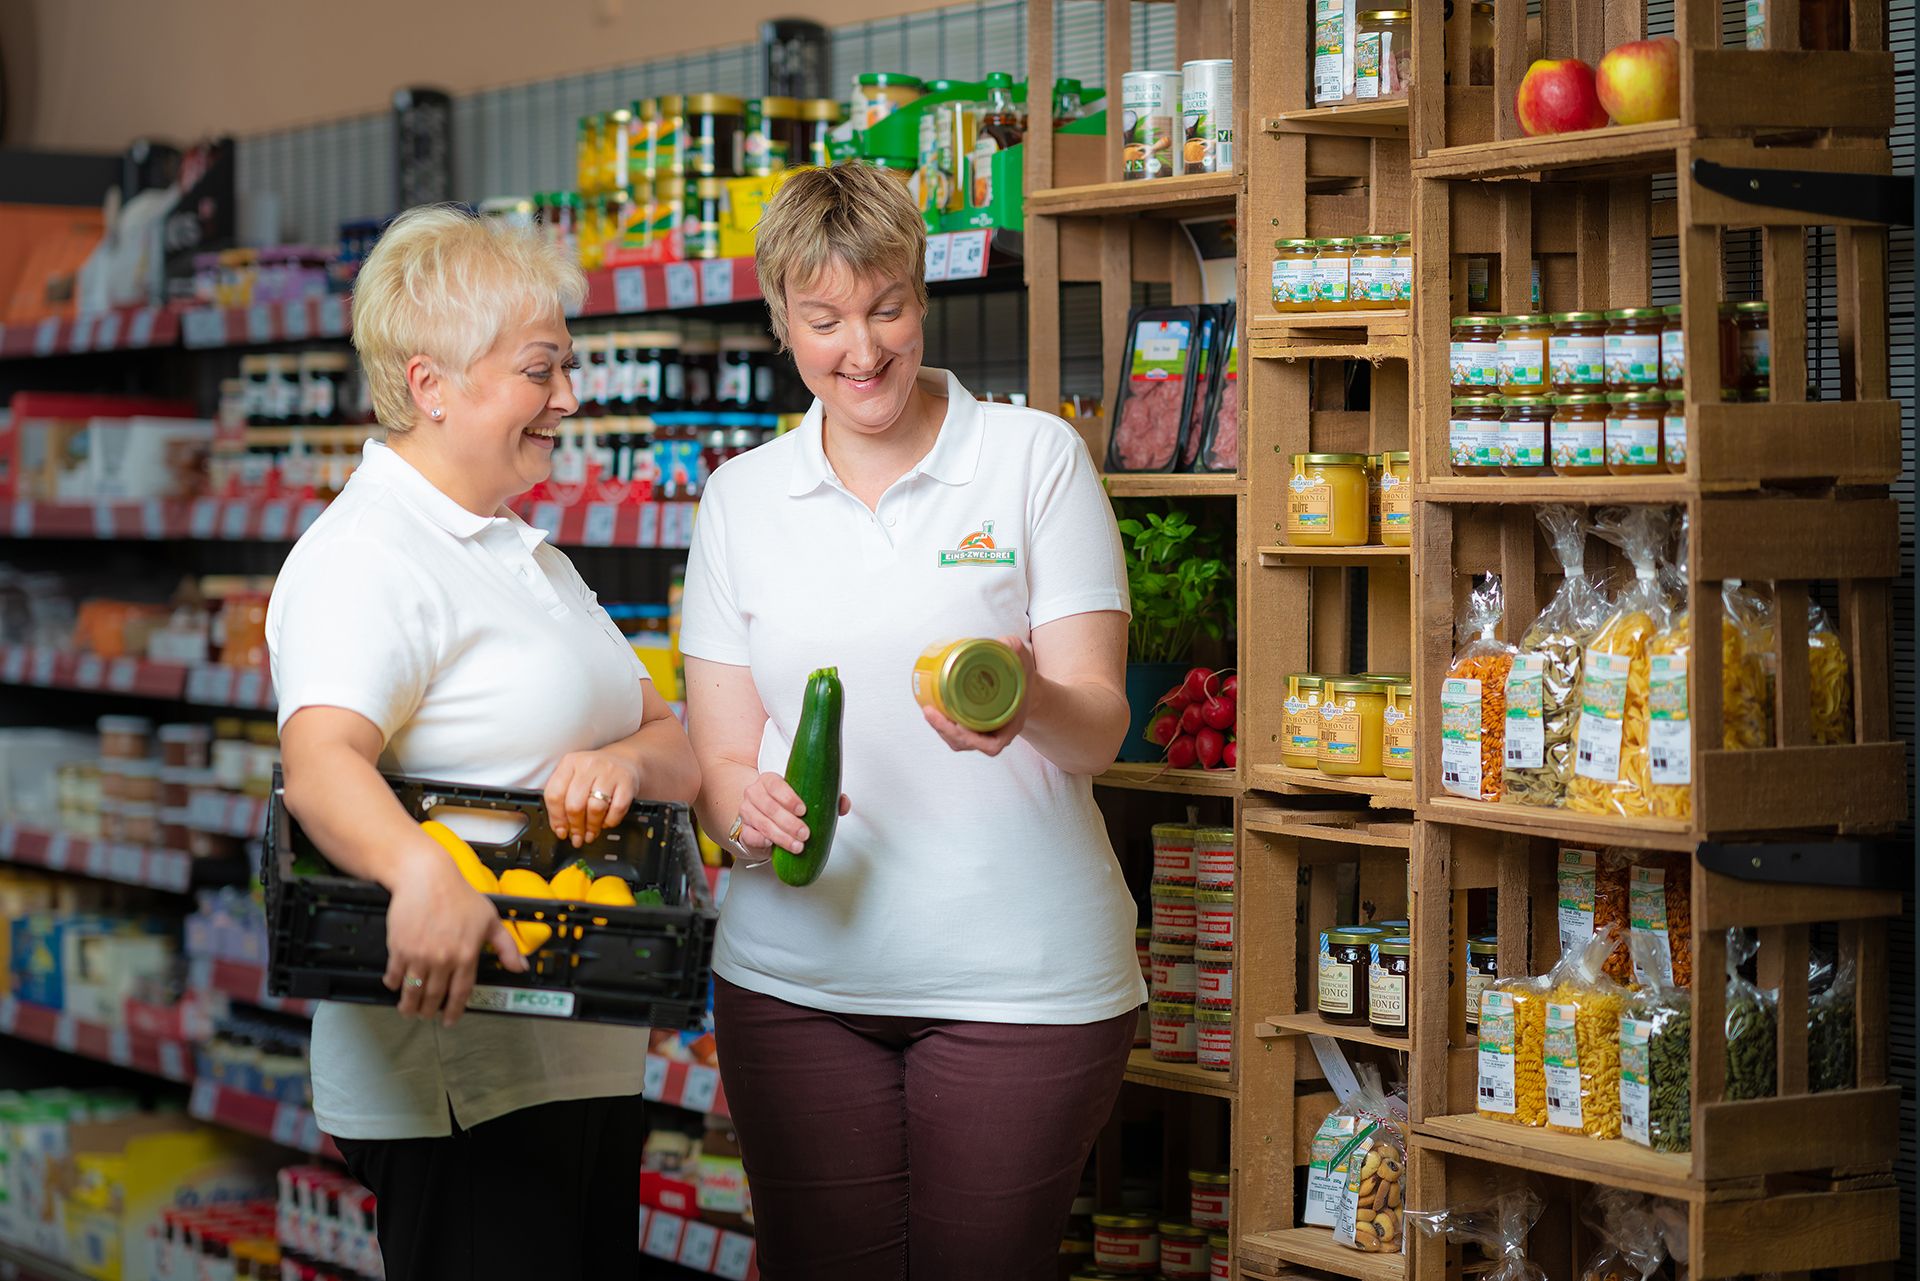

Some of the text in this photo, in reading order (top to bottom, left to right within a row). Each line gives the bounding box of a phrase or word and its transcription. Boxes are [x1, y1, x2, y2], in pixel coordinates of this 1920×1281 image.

[1292, 501, 1308, 513] BLÜTE
[1320, 986, 1348, 998] HONIG
[1371, 998, 1400, 1010] HONIG
